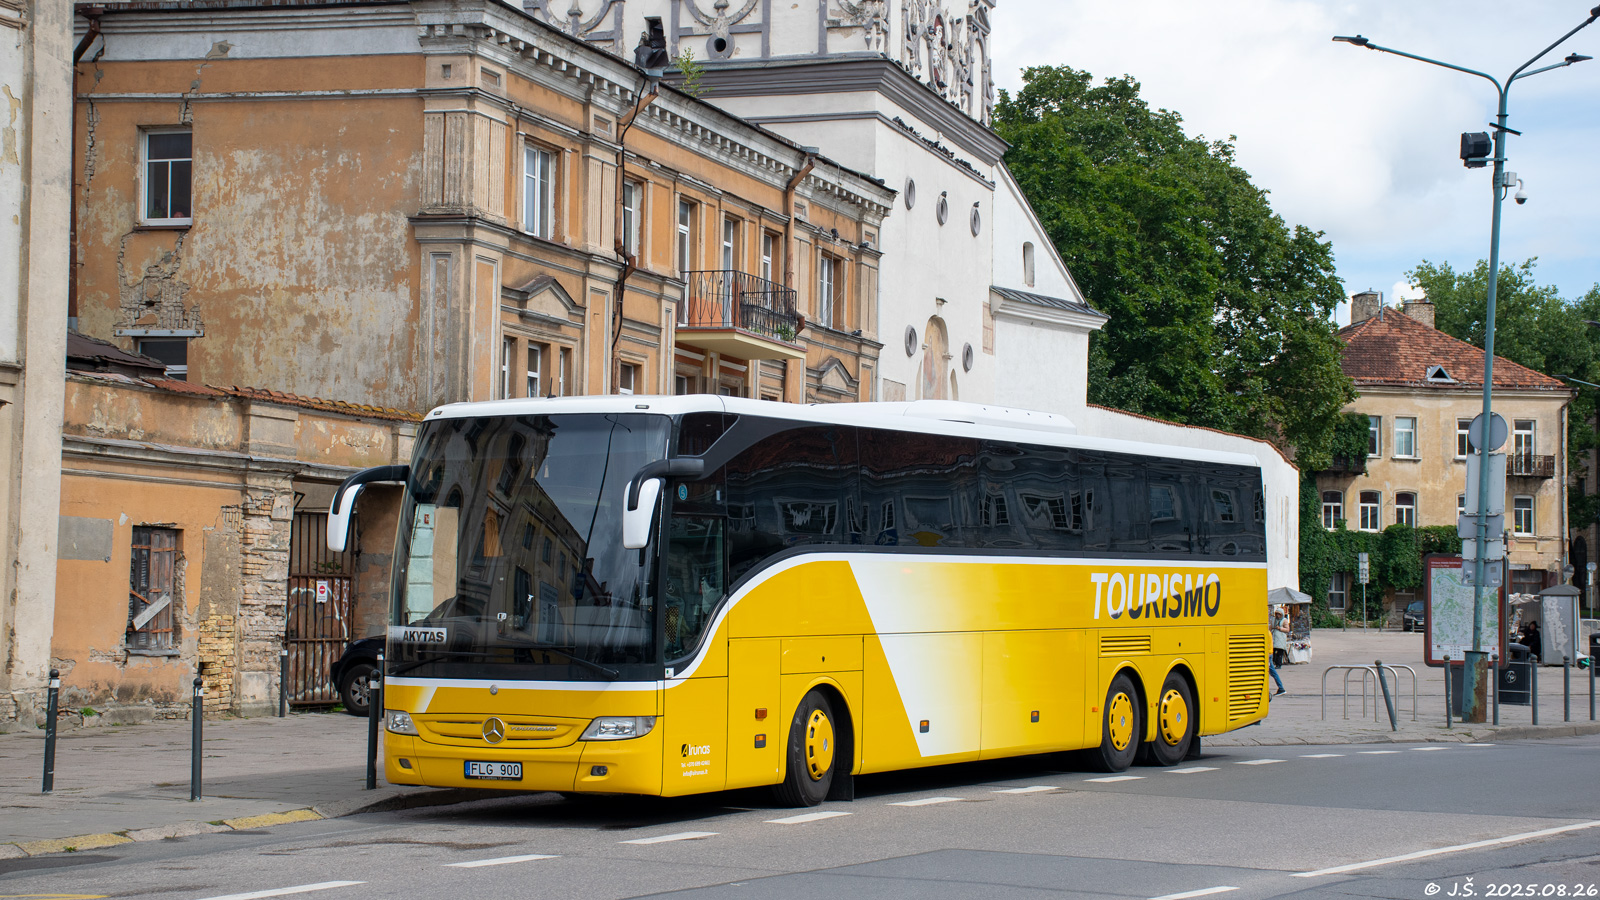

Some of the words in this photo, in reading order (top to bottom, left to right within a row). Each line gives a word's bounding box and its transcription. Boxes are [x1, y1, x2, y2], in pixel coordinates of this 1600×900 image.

[1090, 572, 1221, 619] TOURISMO
[403, 630, 445, 642] AKYTAS
[471, 763, 494, 775] FLG
[500, 764, 520, 776] 900
